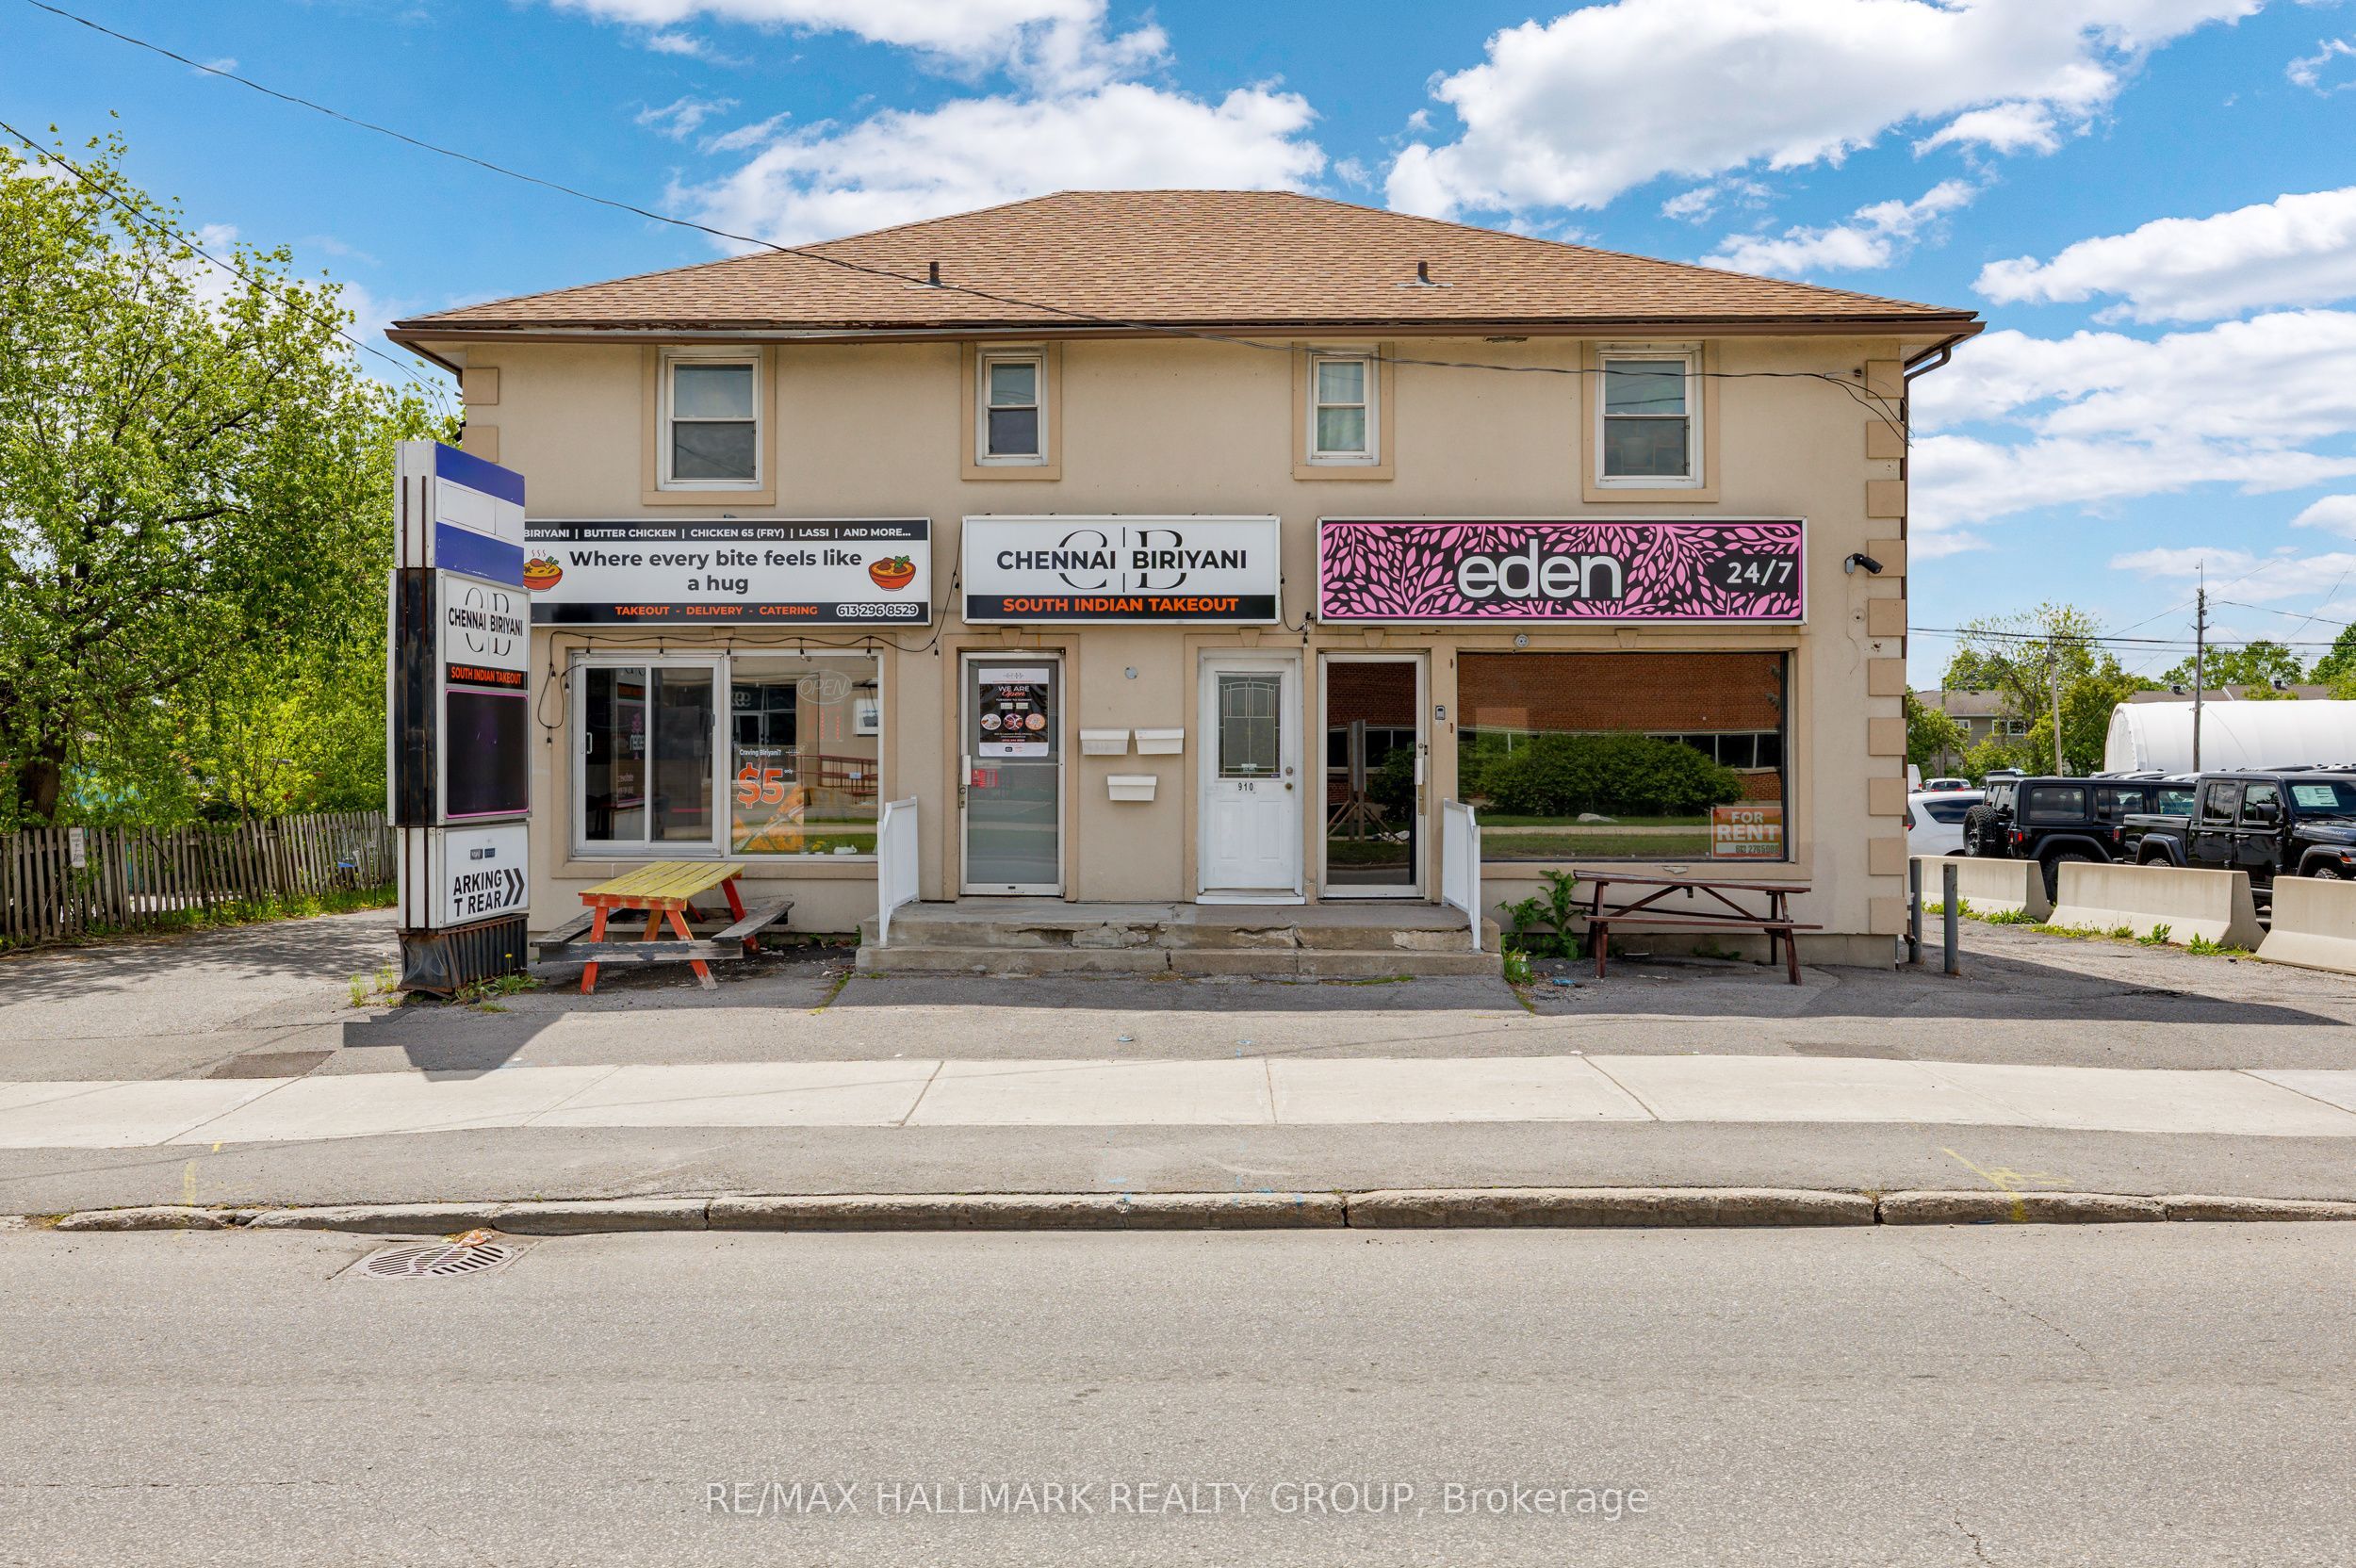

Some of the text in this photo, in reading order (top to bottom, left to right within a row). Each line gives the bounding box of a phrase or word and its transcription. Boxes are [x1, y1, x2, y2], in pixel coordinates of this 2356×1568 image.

[583, 529, 626, 538] BUTTER
[628, 529, 677, 538] CHICKEN
[690, 529, 739, 537] CHICKEN
[741, 529, 754, 537] 65
[756, 528, 785, 539] (FRY)
[798, 528, 829, 537] LASSI
[843, 528, 868, 537] AND
[569, 548, 862, 570] Where every bite feels like
[996, 550, 1247, 570] CHENNAI BIRIYANI
[1457, 538, 1622, 599] eden
[1726, 561, 1793, 586] 24/7
[687, 575, 748, 595] a hug
[614, 606, 818, 616] TAKEOUT DELIVERY CATERING
[1003, 597, 1239, 612] SOUTH INDIAN TAKEOUT
[449, 607, 523, 637] CHENNAI BIRIYANI
[451, 666, 521, 684] SOUTH INDIAN TAKEOUT
[800, 678, 846, 695] OPEN
[739, 748, 759, 757] Craving
[737, 762, 784, 808] $5
[1237, 782, 1253, 792] 910
[1731, 811, 1764, 824] FOR
[1716, 824, 1779, 841] RENT
[453, 869, 501, 896] ARKING
[467, 890, 501, 915] REAR
